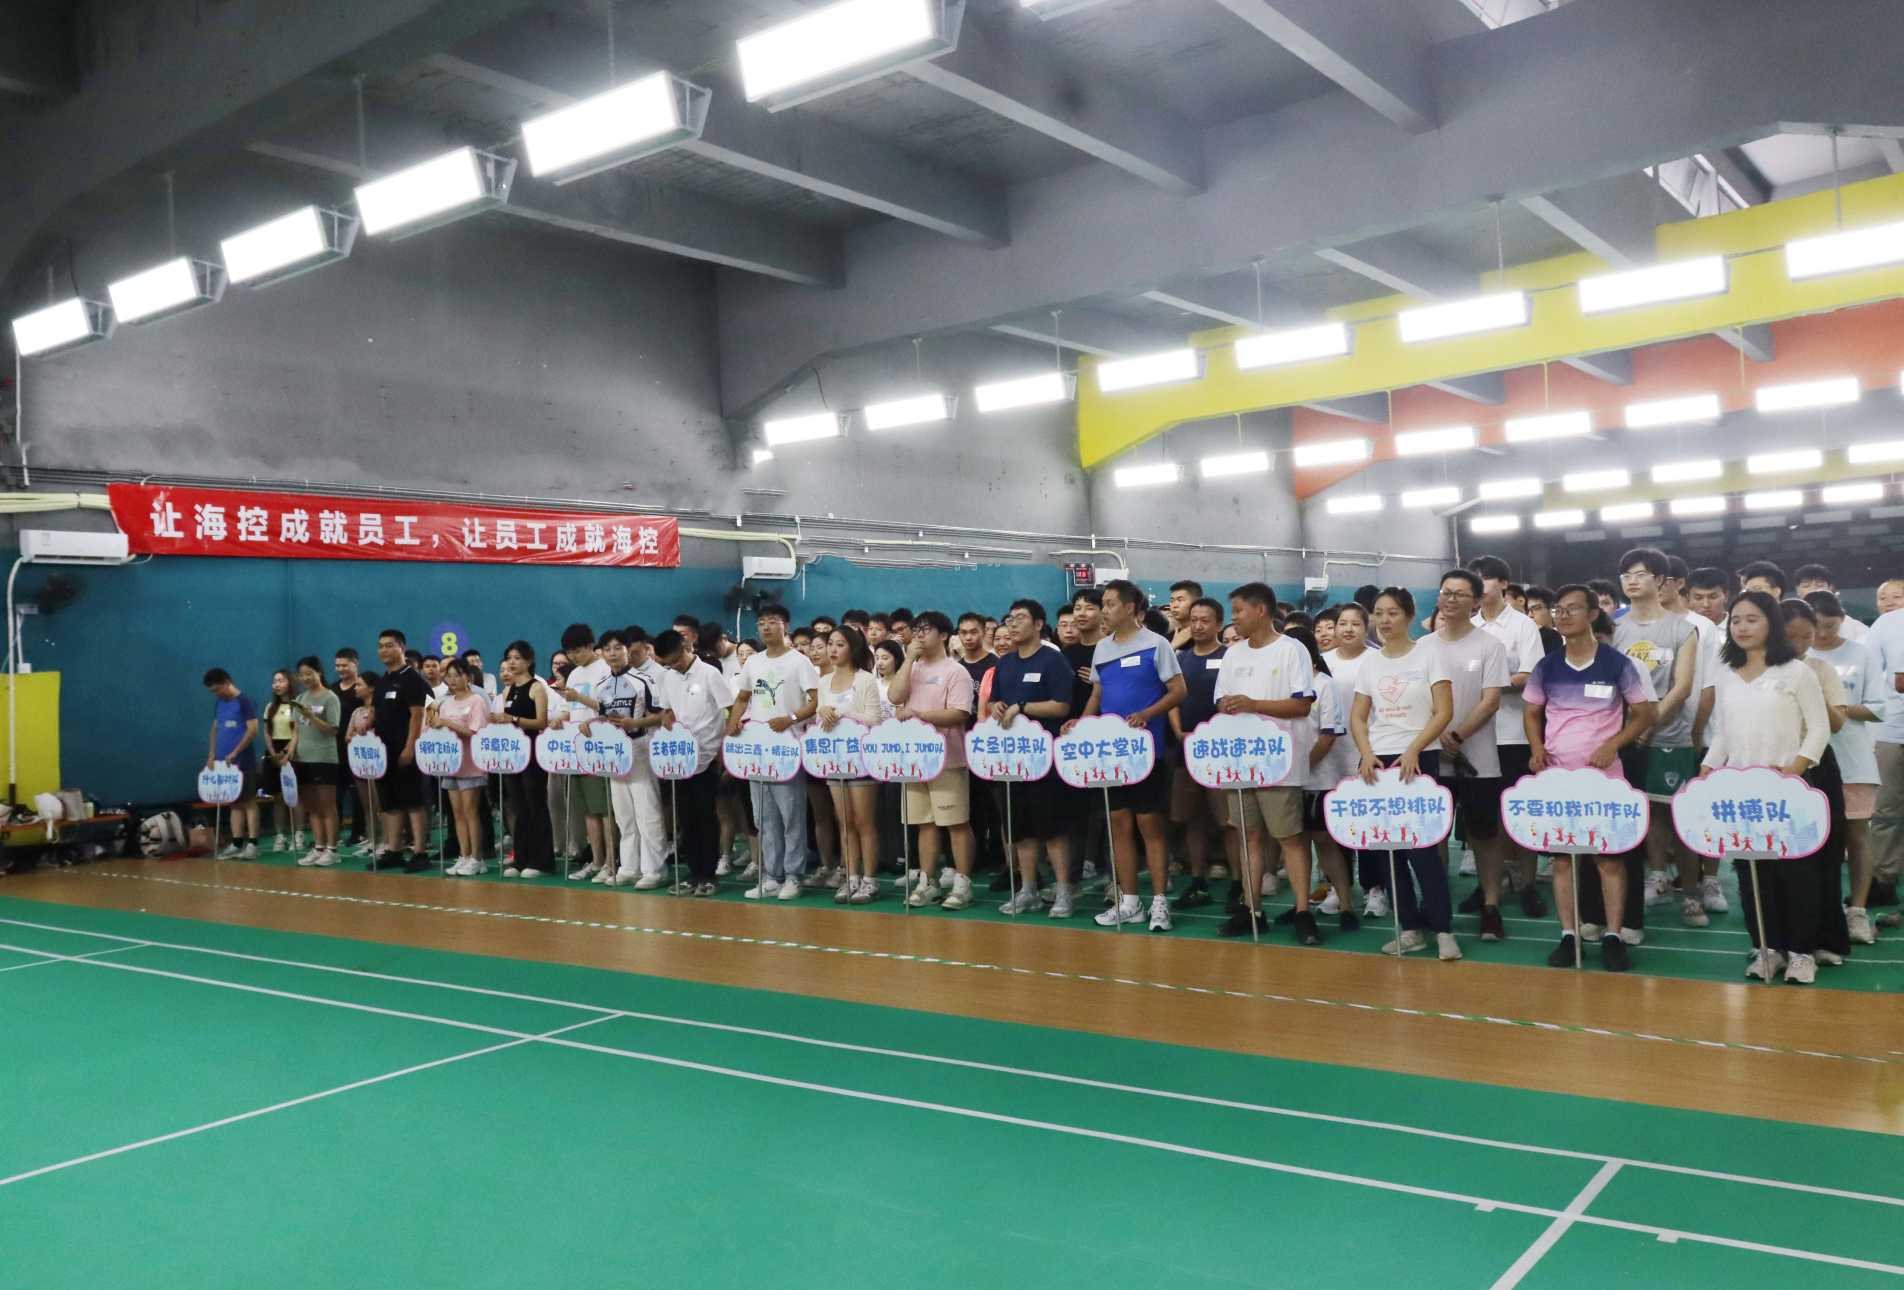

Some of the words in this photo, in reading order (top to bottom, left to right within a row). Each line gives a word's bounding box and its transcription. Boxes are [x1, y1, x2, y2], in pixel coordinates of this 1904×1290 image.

[150, 502, 659, 554] 让海控成就员工，让员工成就海控
[441, 632, 458, 656] 8
[547, 740, 576, 754] 中标
[584, 740, 625, 757] 中标一队
[652, 740, 694, 756] 王者荣耀队
[863, 743, 877, 754] YOU
[971, 734, 1046, 755] 大圣归来队
[1060, 736, 1146, 761] 空中大堂队
[1192, 735, 1287, 759] 速战速决队
[1331, 796, 1446, 818] 干饭不想排队
[1509, 799, 1642, 819] 不要和我们作队
[1711, 799, 1791, 823] 拼搏队
